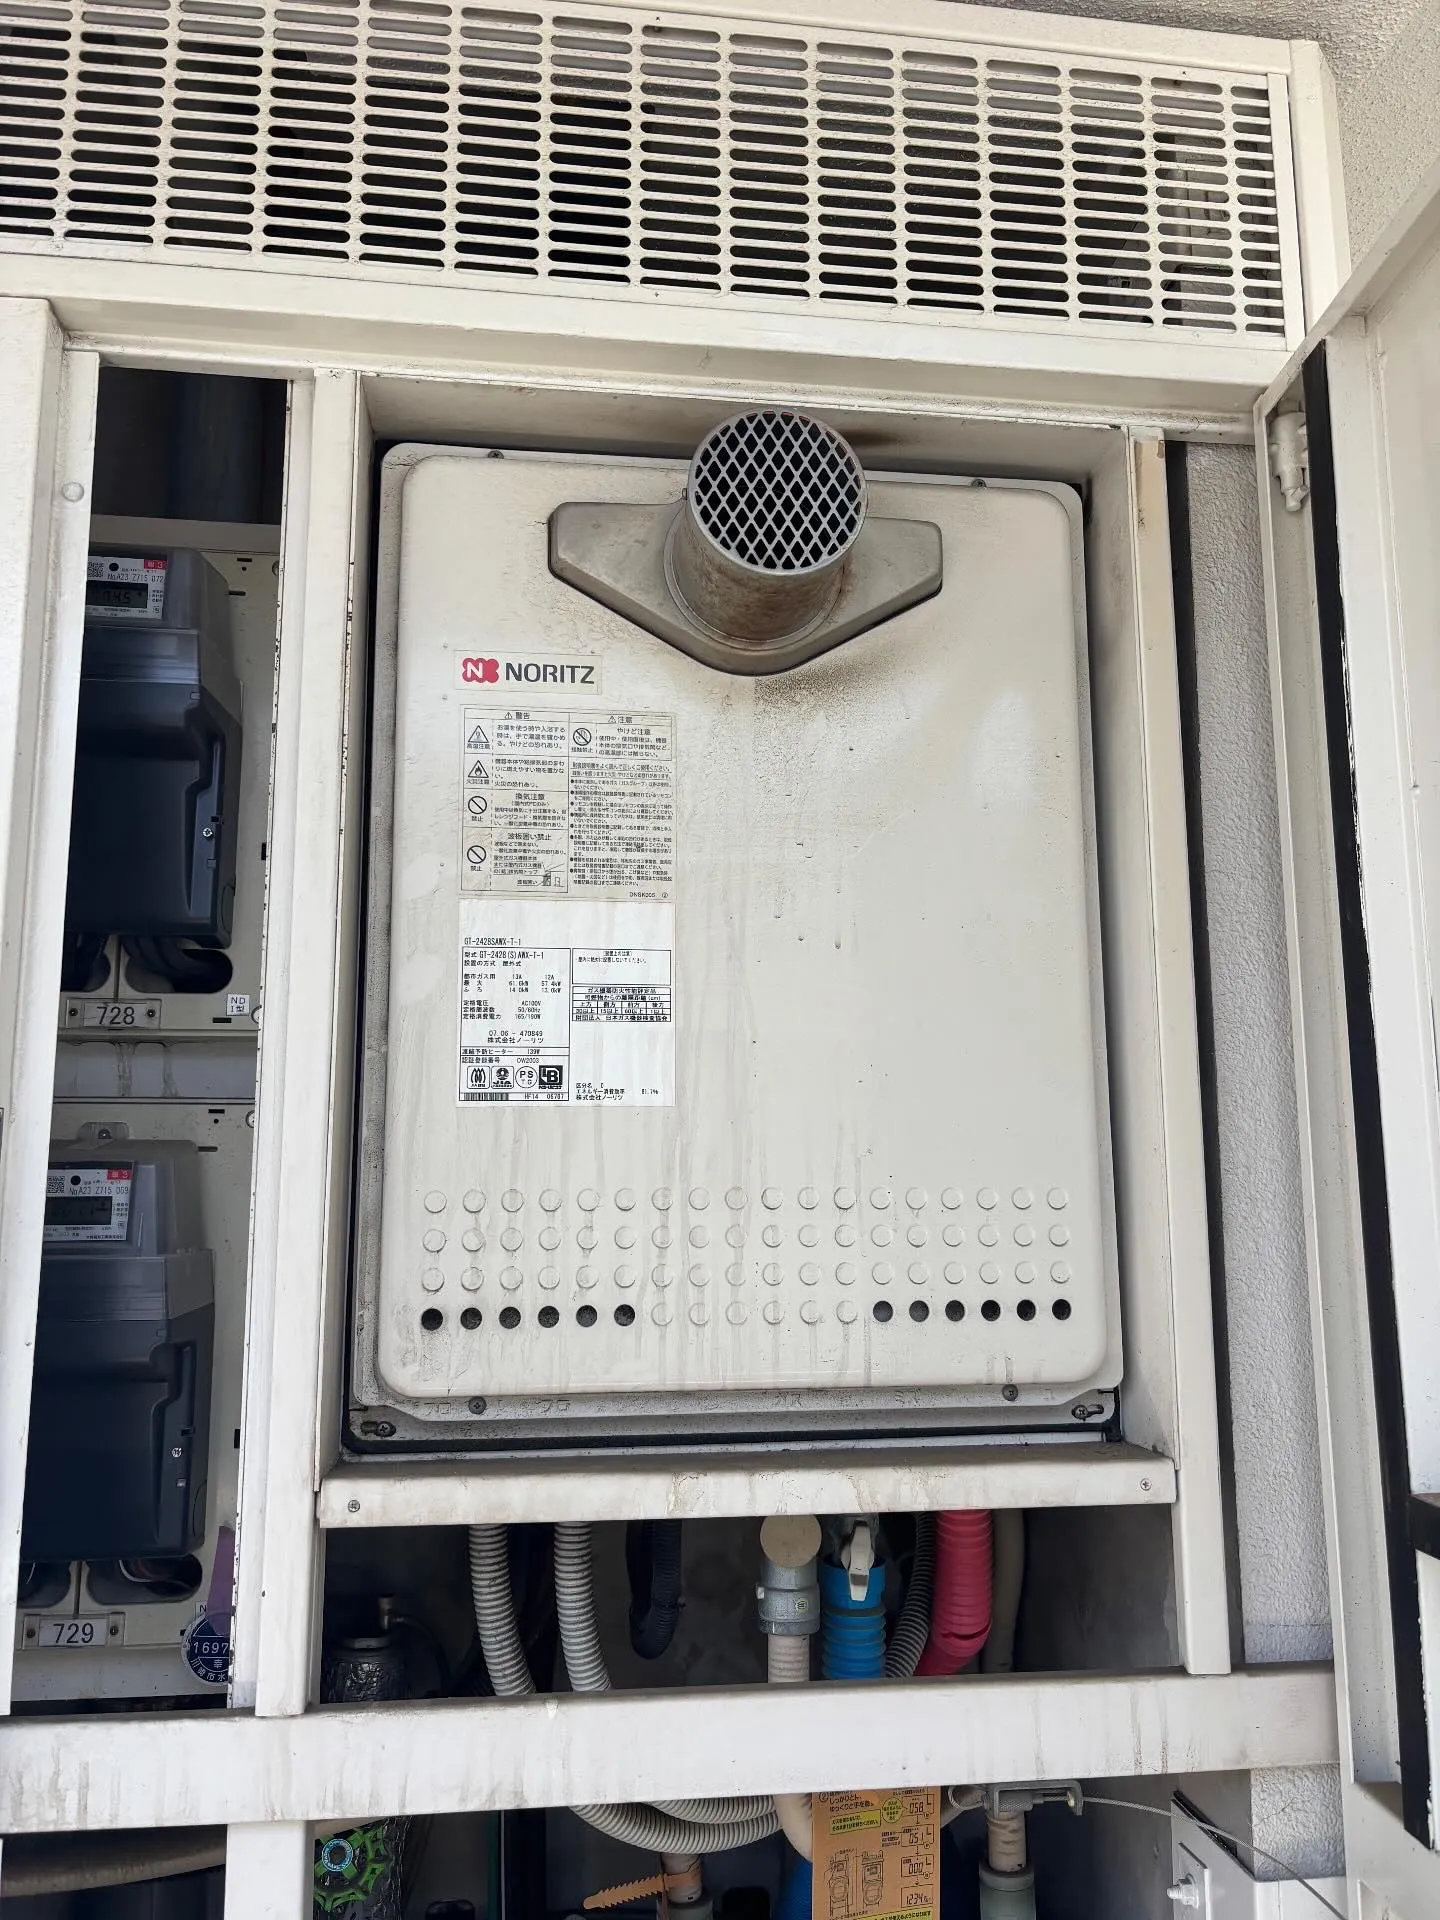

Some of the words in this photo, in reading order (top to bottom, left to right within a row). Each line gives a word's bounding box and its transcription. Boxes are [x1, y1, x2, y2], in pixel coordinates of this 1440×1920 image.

[505, 662, 594, 684] NORITZ
[516, 712, 530, 720] 警告
[618, 716, 632, 724] 注意
[617, 728, 650, 736] やけど注意
[97, 1006, 134, 1025] 728
[53, 1623, 94, 1644] 729
[194, 1642, 229, 1654] 1697
